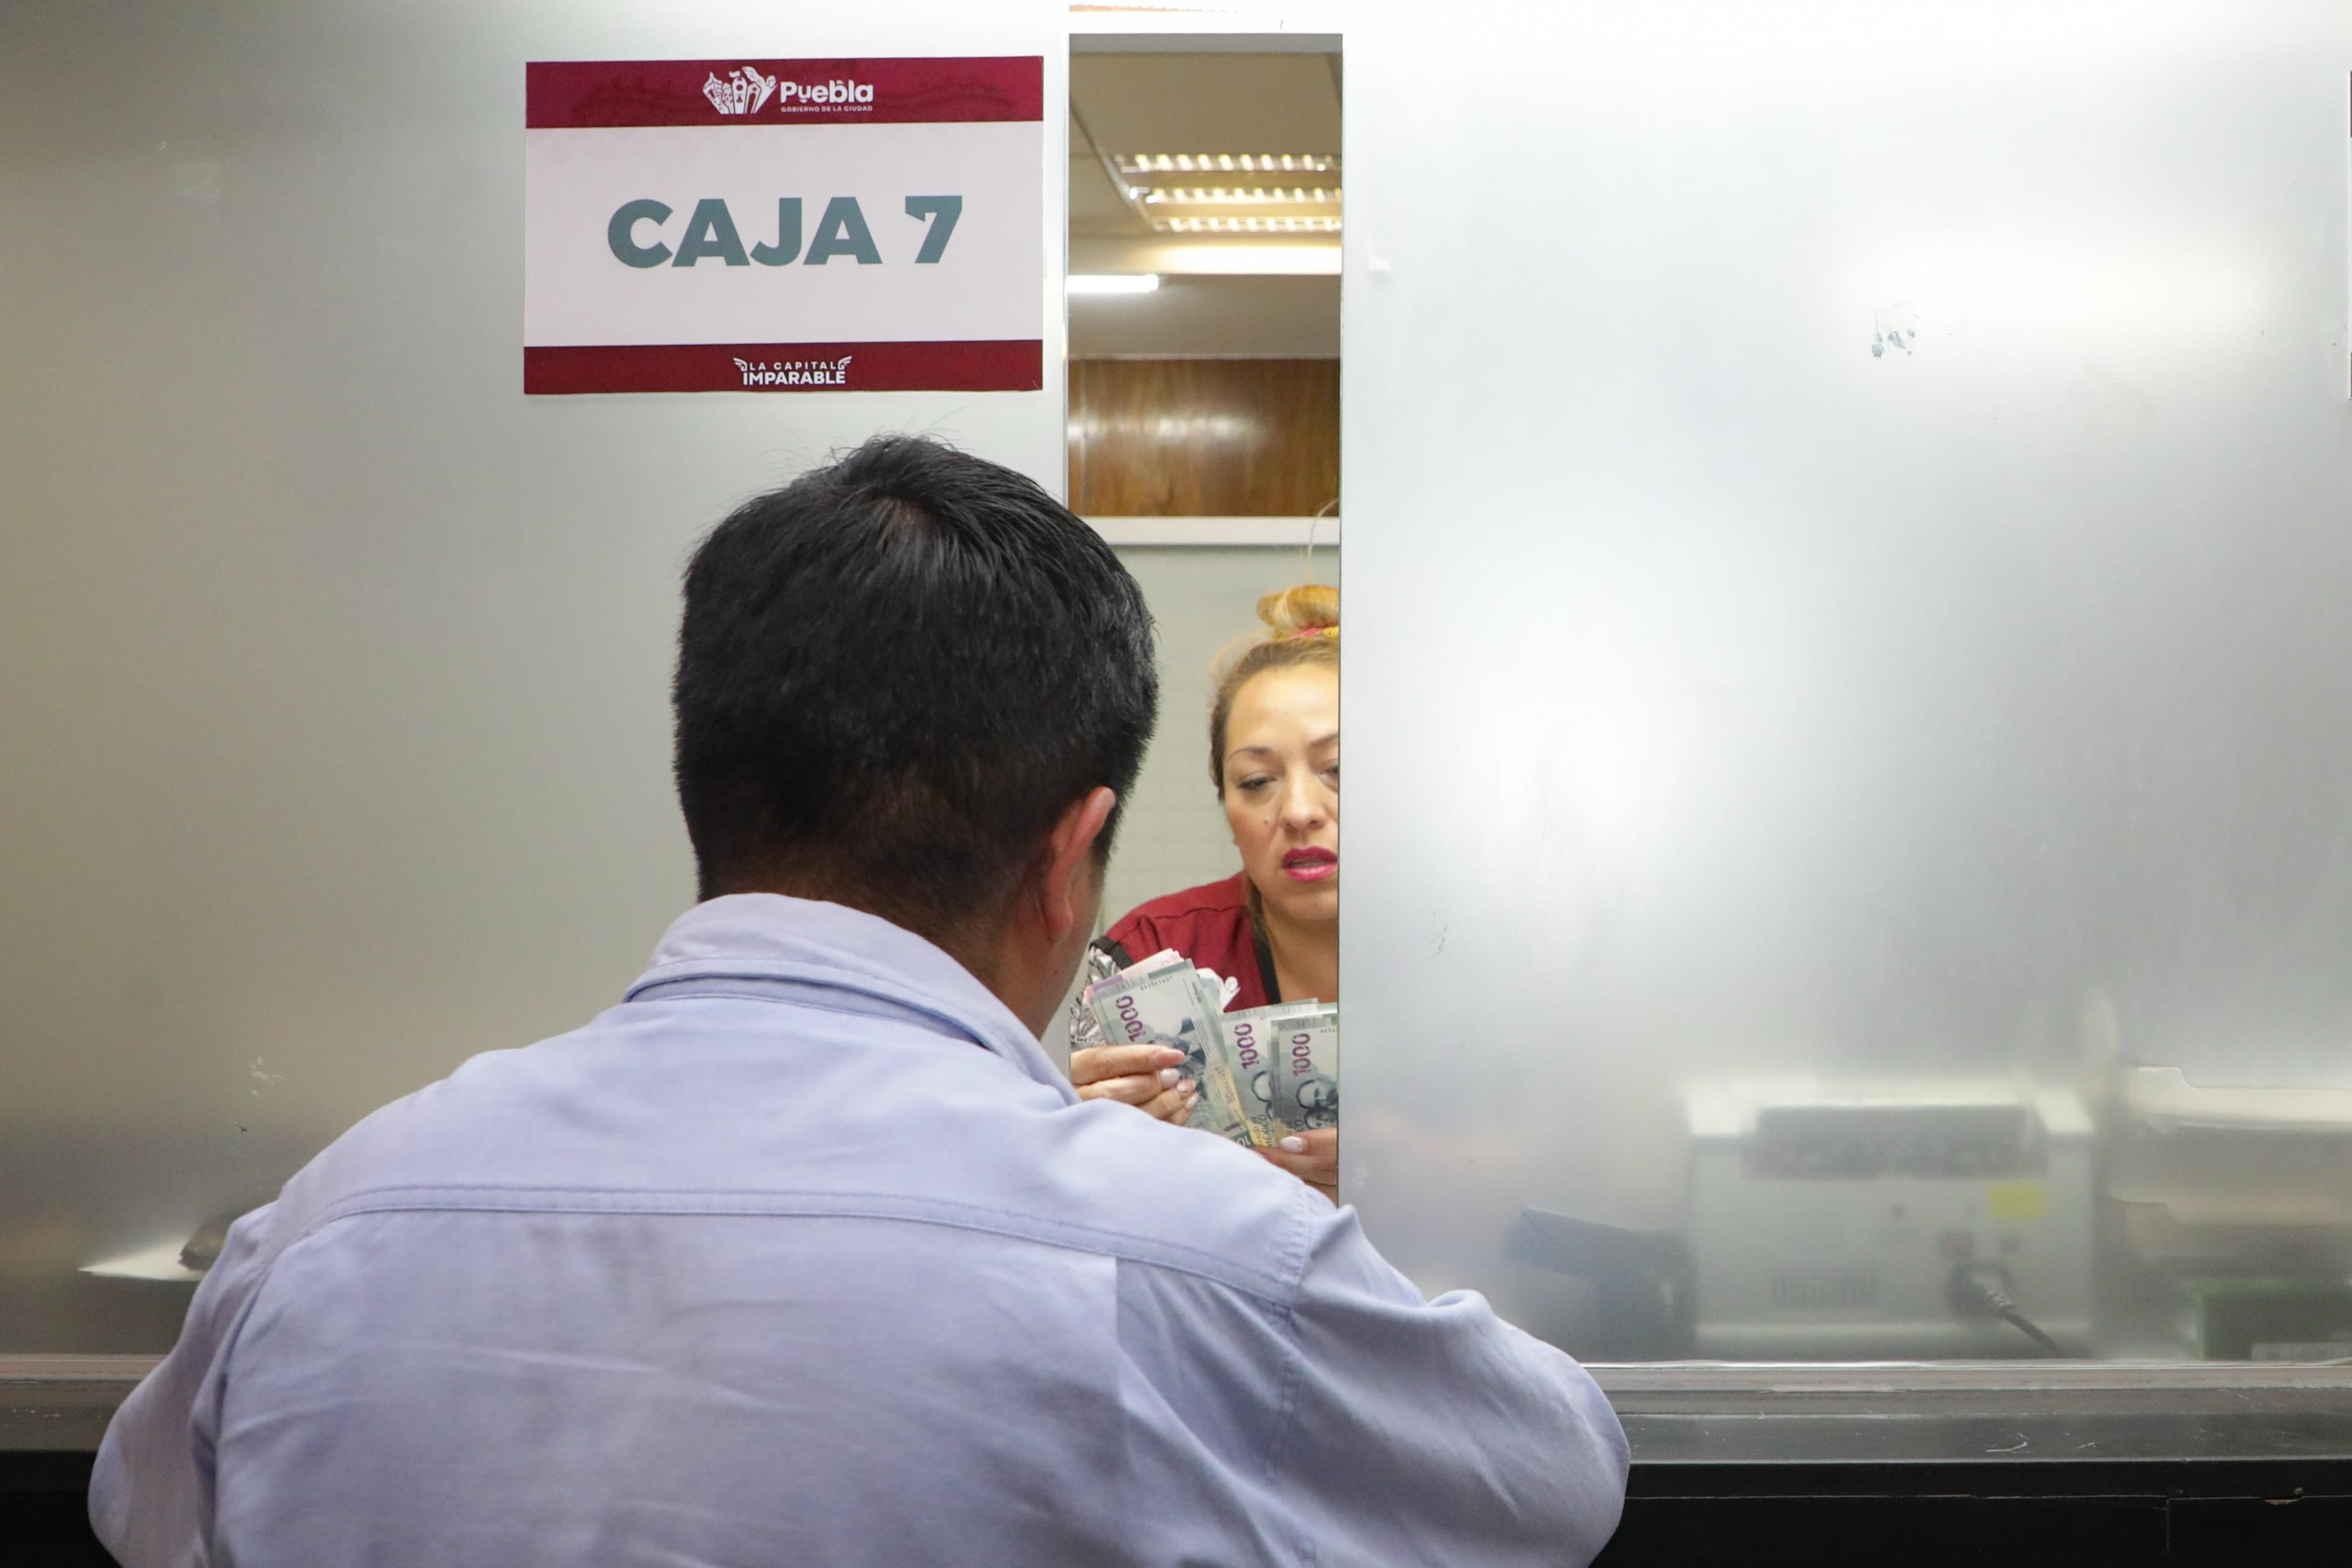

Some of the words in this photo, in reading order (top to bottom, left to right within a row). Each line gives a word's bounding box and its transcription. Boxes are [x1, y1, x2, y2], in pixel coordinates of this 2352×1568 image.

[780, 80, 873, 104] Puebla
[607, 197, 883, 269] CAJA
[905, 195, 962, 264] 7
[743, 371, 846, 385] IMPARABLE
[749, 362, 766, 371] LA
[774, 361, 837, 370] CAPITAL
[1115, 995, 1146, 1042] 1000
[1234, 1023, 1259, 1069] 1000
[1292, 1033, 1311, 1076] 1000
